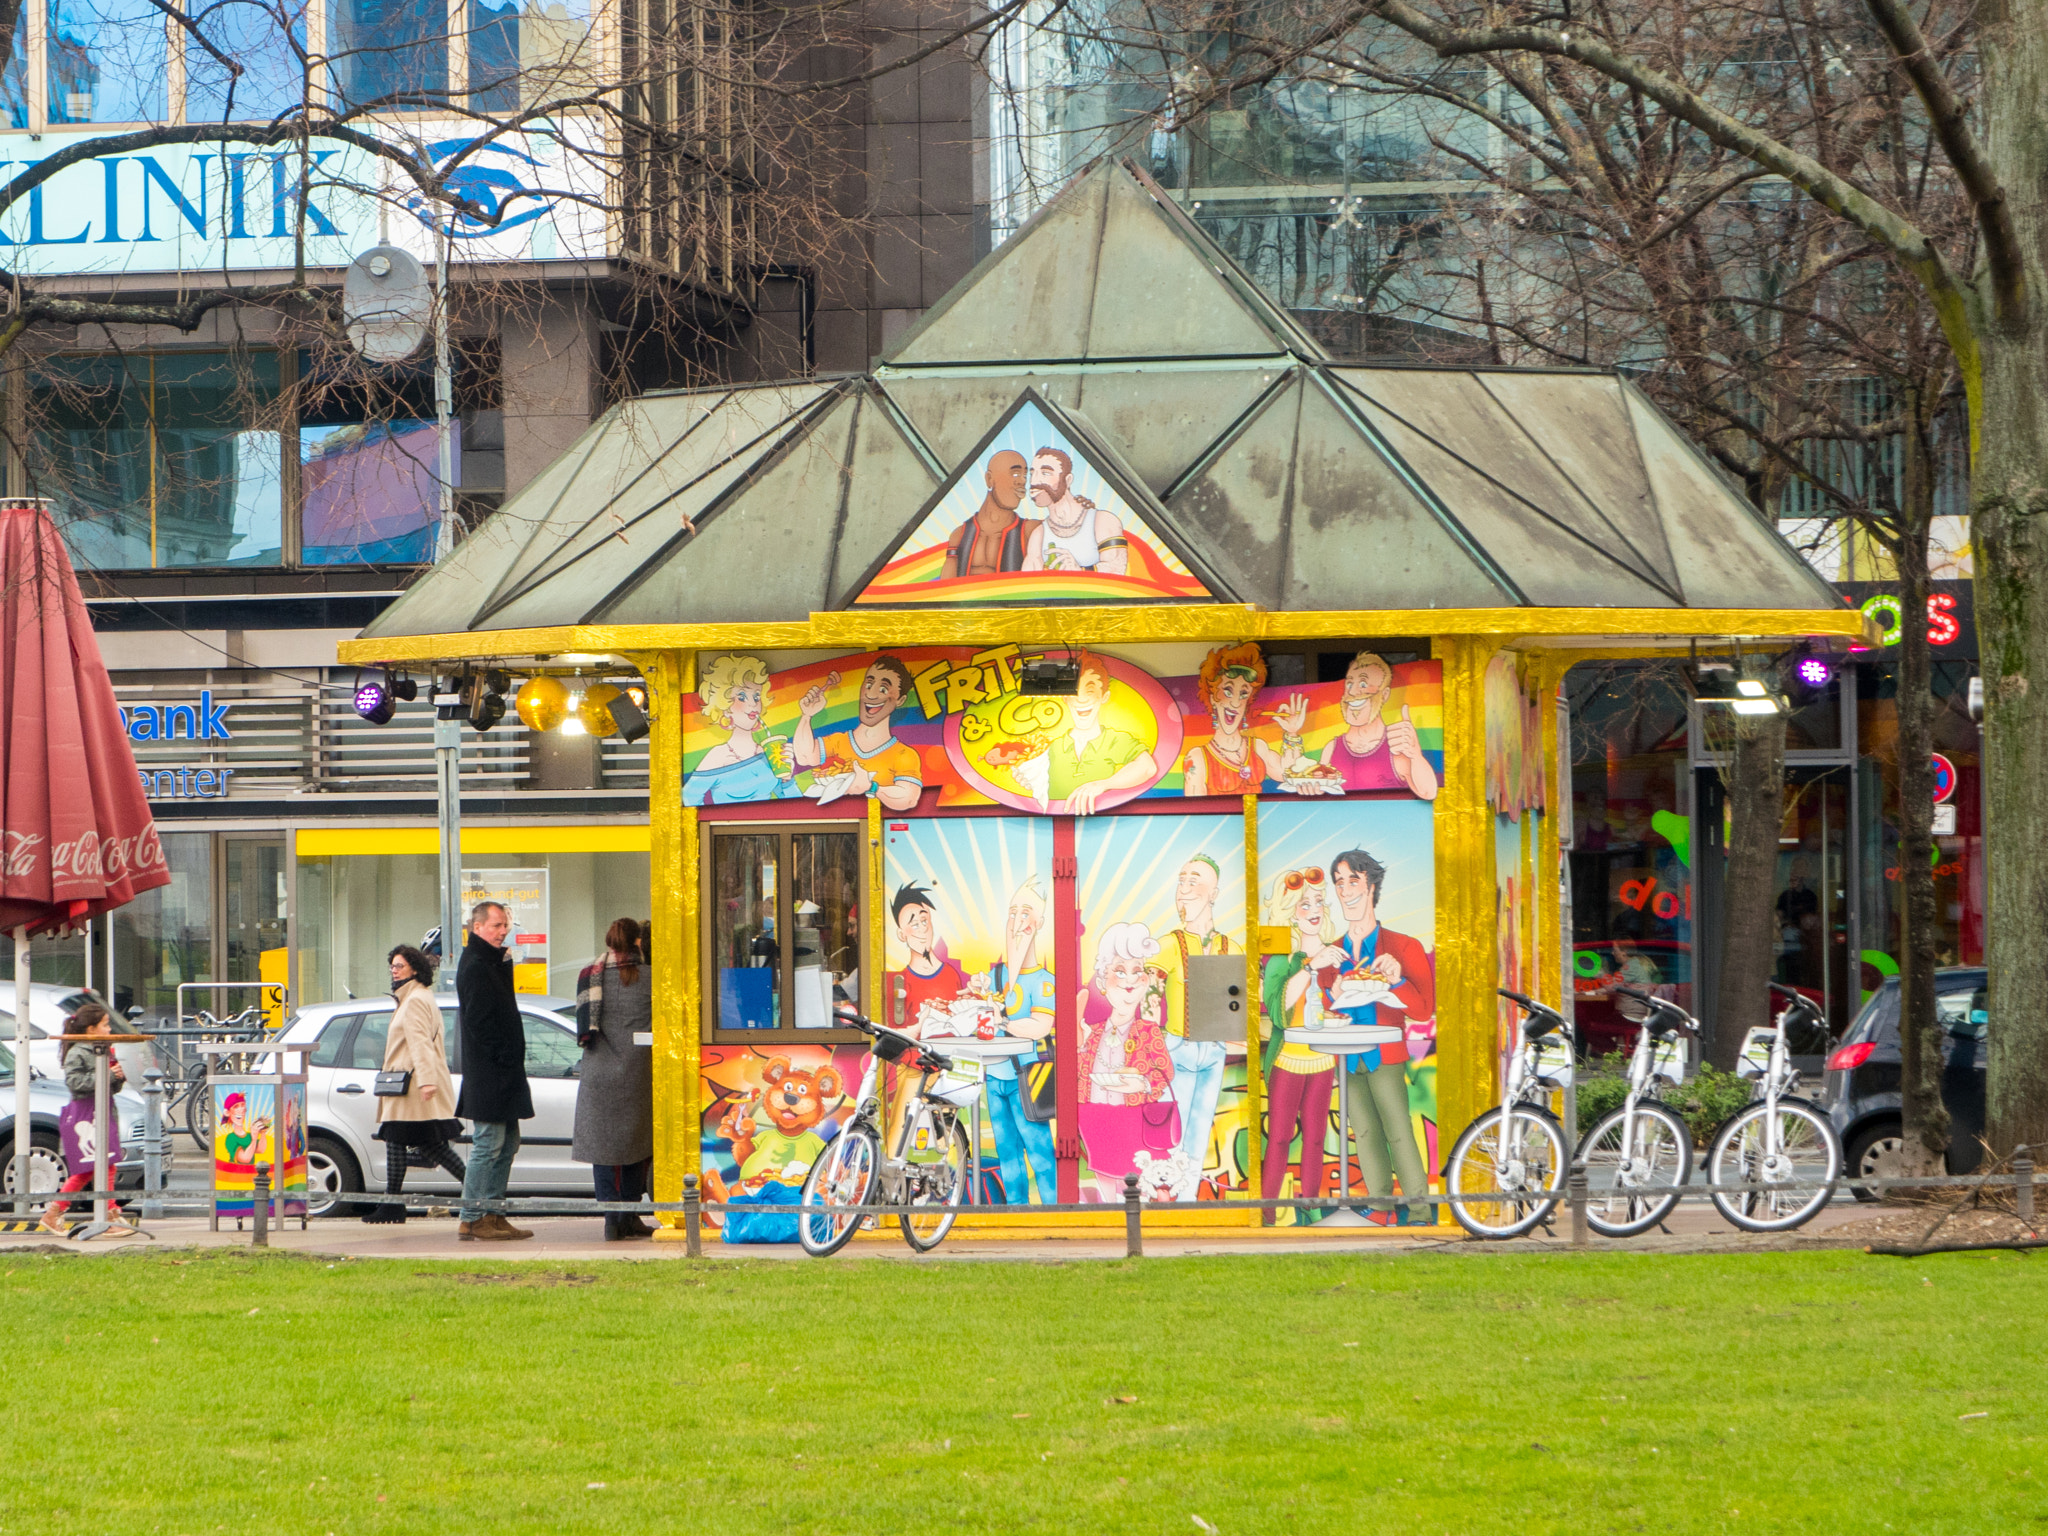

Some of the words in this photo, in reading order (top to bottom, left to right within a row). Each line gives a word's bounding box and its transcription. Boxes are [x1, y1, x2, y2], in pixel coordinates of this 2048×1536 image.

[0, 150, 349, 246] LINIK
[118, 690, 232, 740] ank
[961, 713, 992, 742] &
